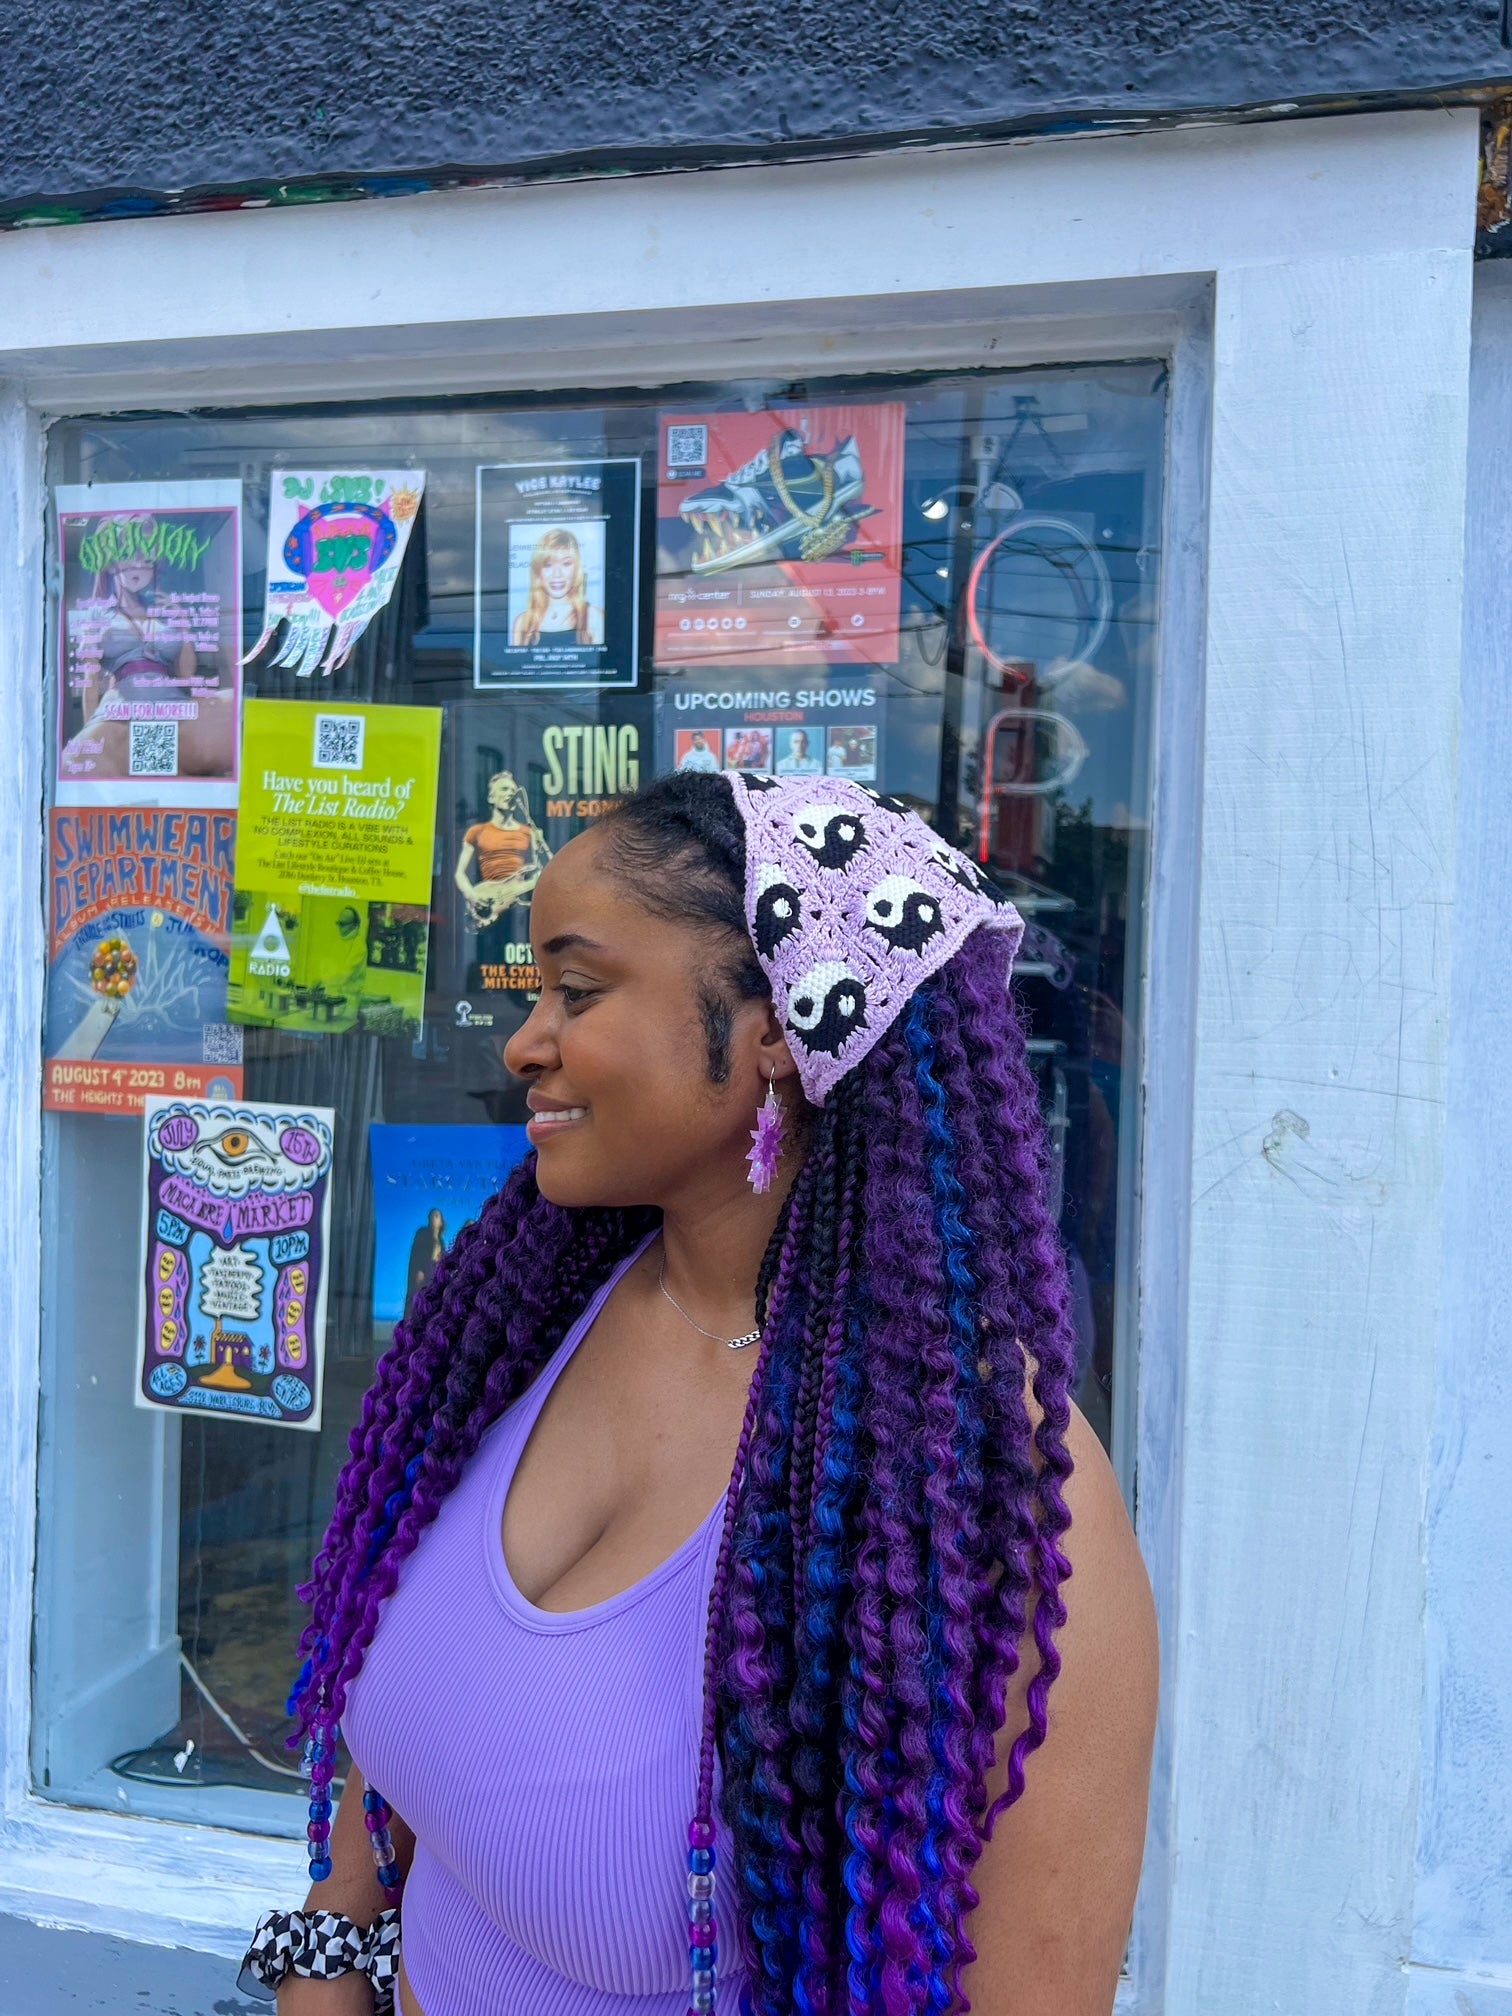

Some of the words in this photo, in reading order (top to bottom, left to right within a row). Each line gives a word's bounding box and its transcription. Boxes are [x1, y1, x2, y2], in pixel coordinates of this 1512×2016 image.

[105, 702, 130, 720] SCAN
[132, 702, 152, 719] FOR
[674, 691, 791, 711] UPCOMING
[795, 688, 877, 708] SHOWS
[743, 710, 804, 722] HOUSTON
[541, 723, 640, 797] STING
[262, 771, 304, 792] Have
[307, 780, 338, 798] you
[342, 774, 391, 799] heard
[393, 777, 416, 800] of
[272, 793, 305, 815] The
[306, 795, 340, 817] List
[342, 798, 405, 821] Radio?
[547, 799, 575, 818] MY
[254, 825, 268, 835] NO
[341, 832, 359, 842] ALL
[362, 833, 405, 845] SOUNDS
[406, 836, 414, 846] &
[261, 816, 280, 826] THE
[282, 817, 302, 827] LIST
[304, 819, 335, 830] RADIO
[337, 821, 346, 831] IS
[348, 822, 356, 831] A
[358, 823, 381, 833] VIBE
[383, 824, 409, 834] WITH
[54, 811, 236, 877] SWIMWEAR
[278, 837, 330, 850] LIFESTYLE
[331, 842, 388, 854] CURATIONS
[54, 907, 99, 951] ALBUM
[110, 894, 186, 916] RELEASE
[505, 941, 537, 965] OCT
[249, 960, 291, 978] RADIO
[481, 964, 507, 977] THE
[52, 1065, 111, 1086] AUGUST
[128, 1068, 165, 1089] 2023
[51, 1087, 76, 1104] THE
[80, 1090, 124, 1106] HEIGHTS
[163, 1121, 194, 1147] JULY
[161, 1183, 225, 1226] MACABRE
[235, 1194, 312, 1229] MARKET
[158, 1211, 185, 1240] 5PM
[275, 1236, 308, 1259] 10PM
